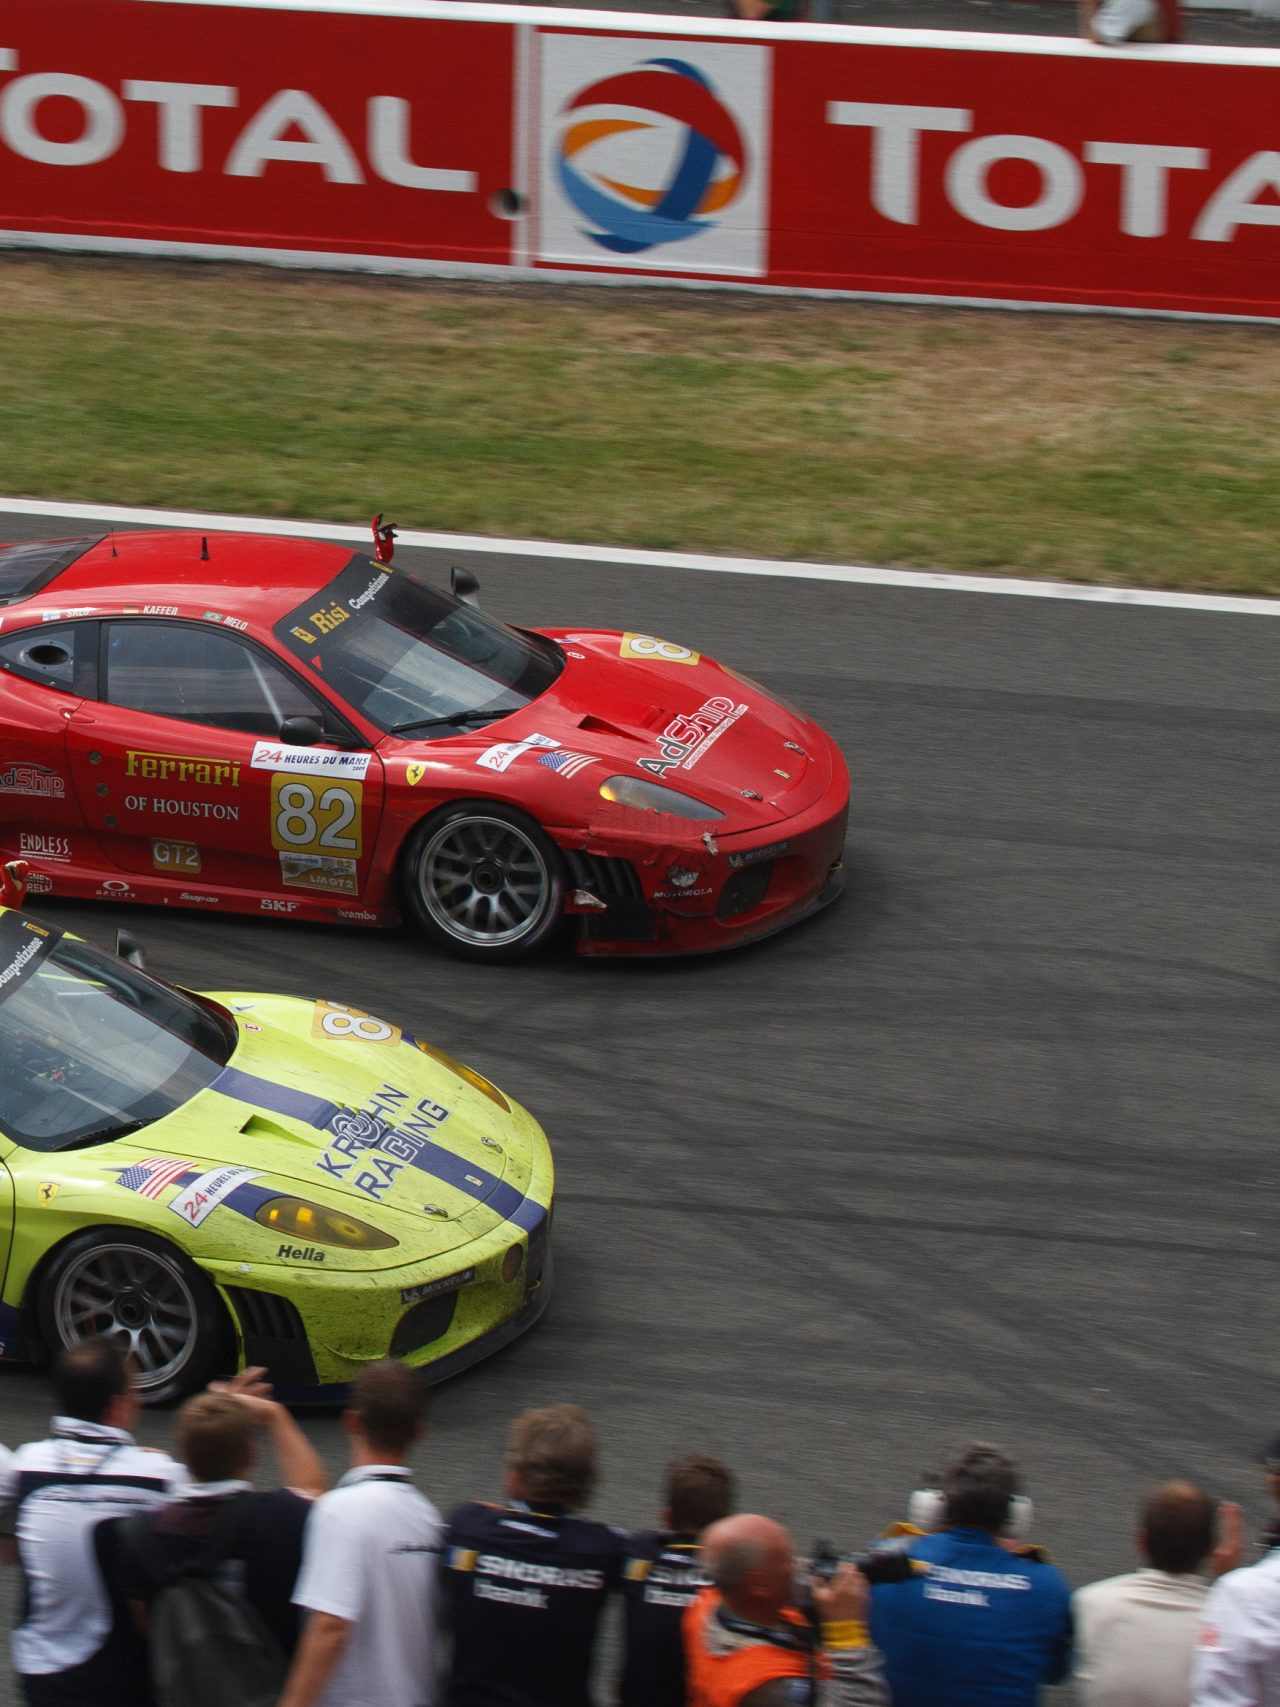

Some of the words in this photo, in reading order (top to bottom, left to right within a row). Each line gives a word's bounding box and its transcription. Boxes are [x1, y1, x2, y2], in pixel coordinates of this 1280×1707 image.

[143, 605, 179, 616] KAFFER
[309, 601, 351, 634] Risi
[223, 616, 249, 631] MELO
[637, 696, 736, 779] AdShip
[125, 750, 240, 787] Ferrari
[255, 750, 283, 763] 24
[284, 754, 321, 765] HEURES
[322, 756, 337, 765] DU
[339, 757, 368, 766] MANS
[489, 748, 509, 770] 24
[125, 796, 147, 811] OF
[153, 797, 239, 821] HOUSTON
[276, 782, 358, 850] 82
[20, 832, 69, 854] ENDLESS
[153, 842, 198, 867] GT2
[260, 899, 300, 912] SKF
[354, 1098, 450, 1200] RACING
[184, 1191, 208, 1220] 24
[277, 1244, 326, 1262] Hella
